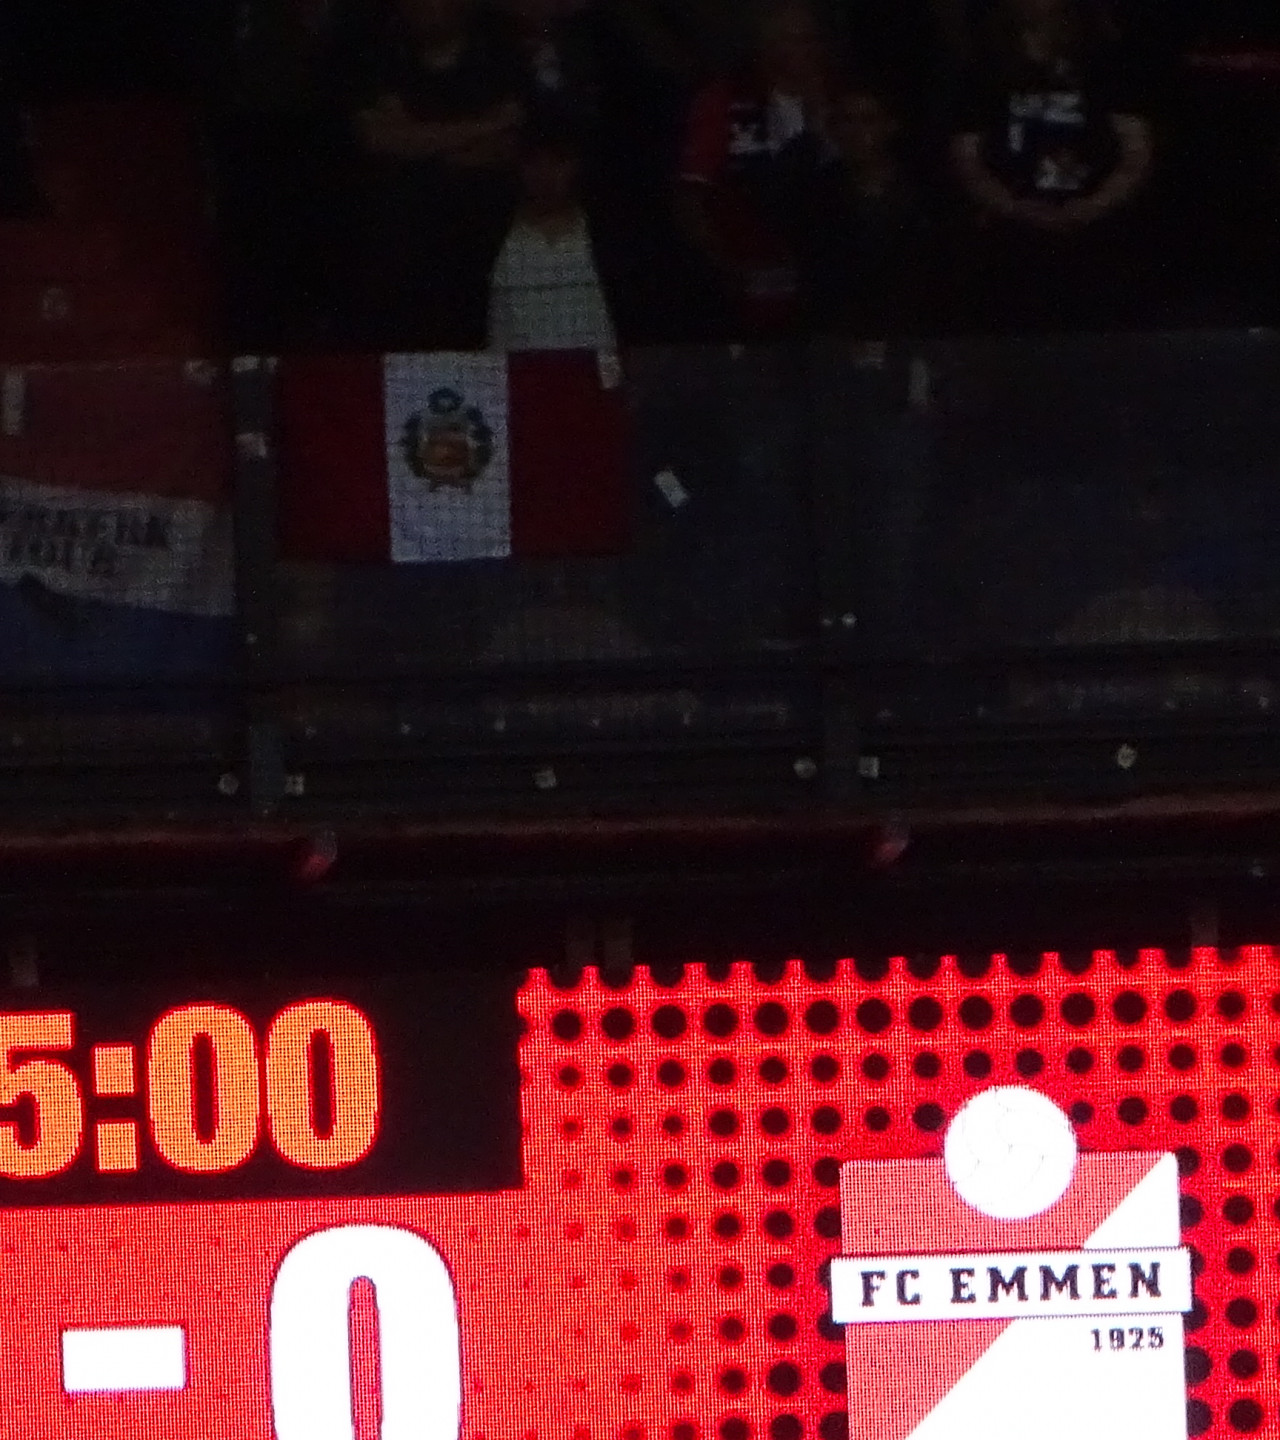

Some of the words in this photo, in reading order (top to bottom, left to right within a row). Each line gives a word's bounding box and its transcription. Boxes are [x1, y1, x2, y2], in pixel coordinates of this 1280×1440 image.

[860, 1268, 923, 1308] FC
[949, 1261, 1164, 1304] EMMEN
[1090, 1325, 1167, 1352] 1925
